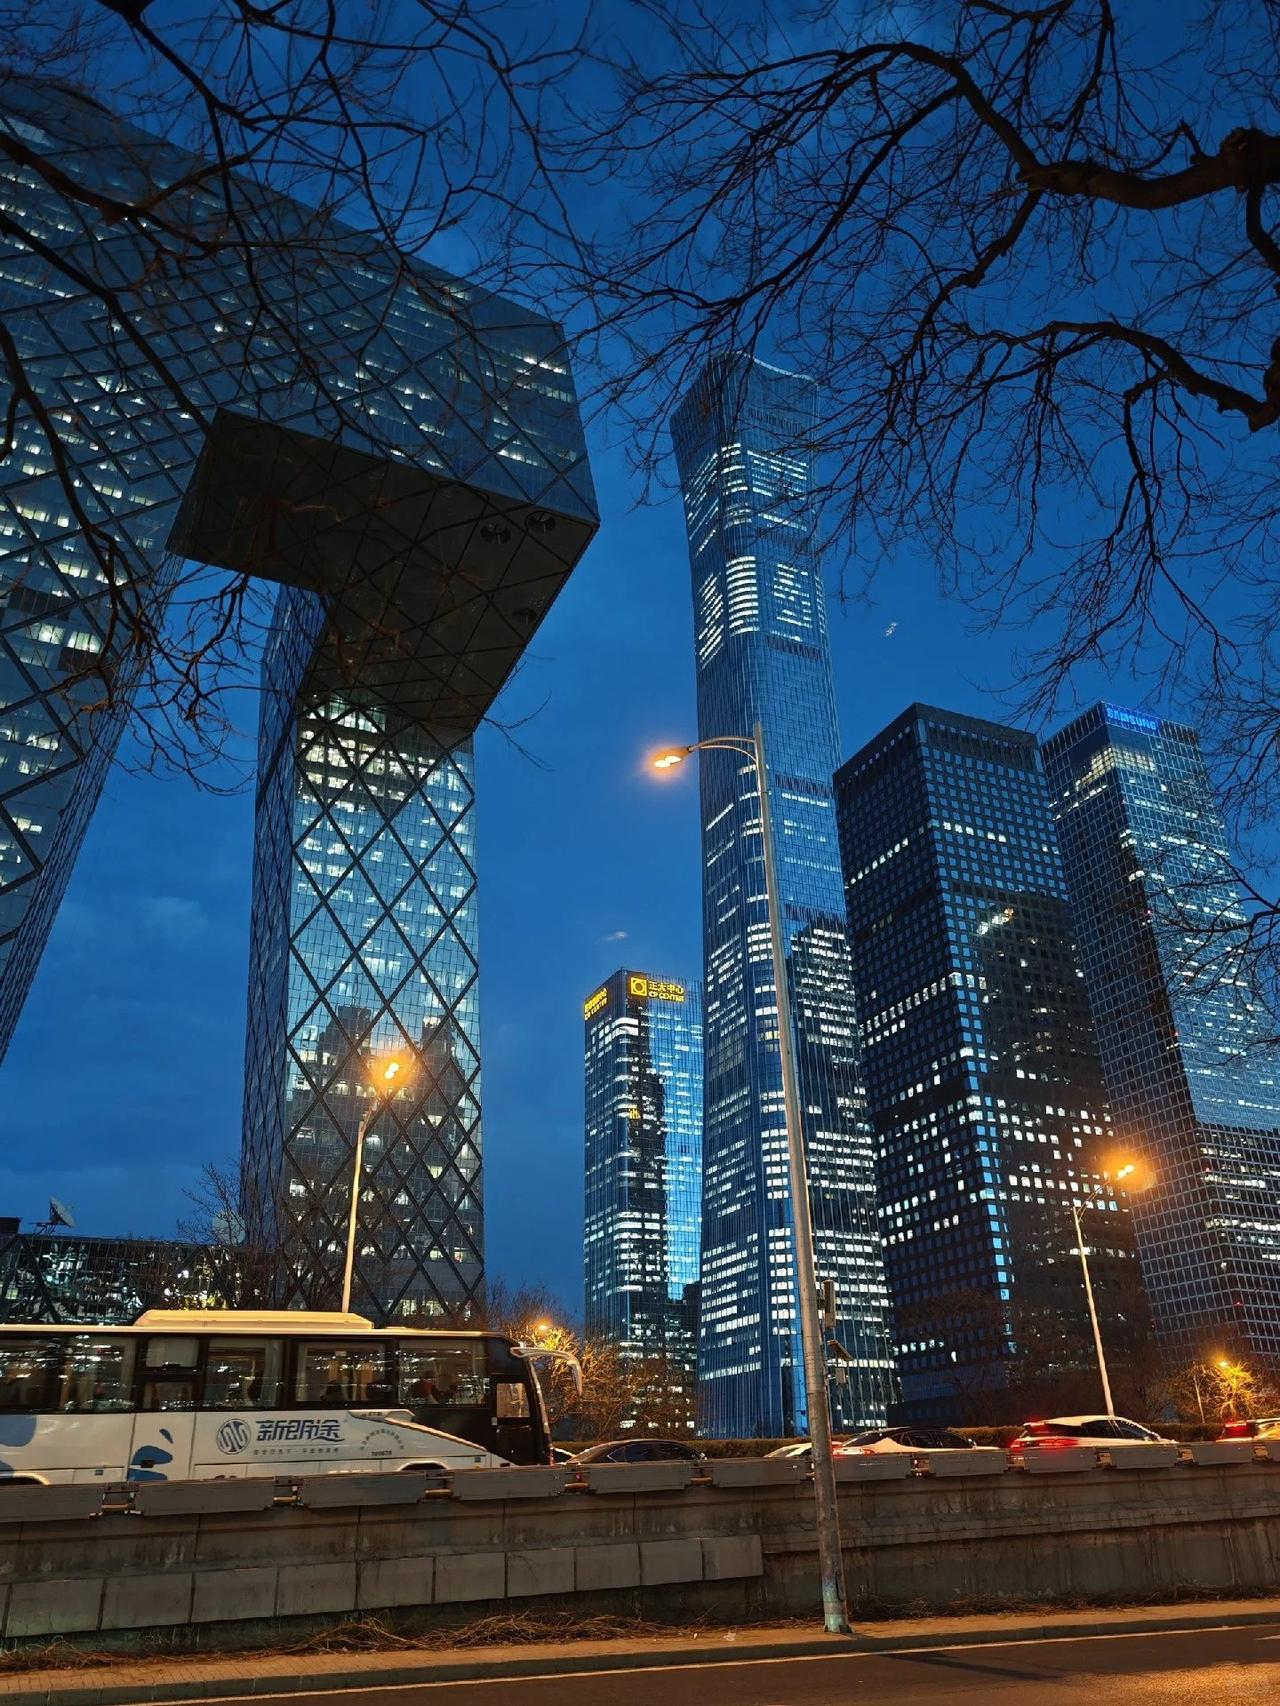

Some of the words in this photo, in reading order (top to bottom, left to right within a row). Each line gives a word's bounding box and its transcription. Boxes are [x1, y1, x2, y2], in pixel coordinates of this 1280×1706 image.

[1106, 708, 1157, 730] SAMSUNG
[648, 980, 684, 994] 正大中心
